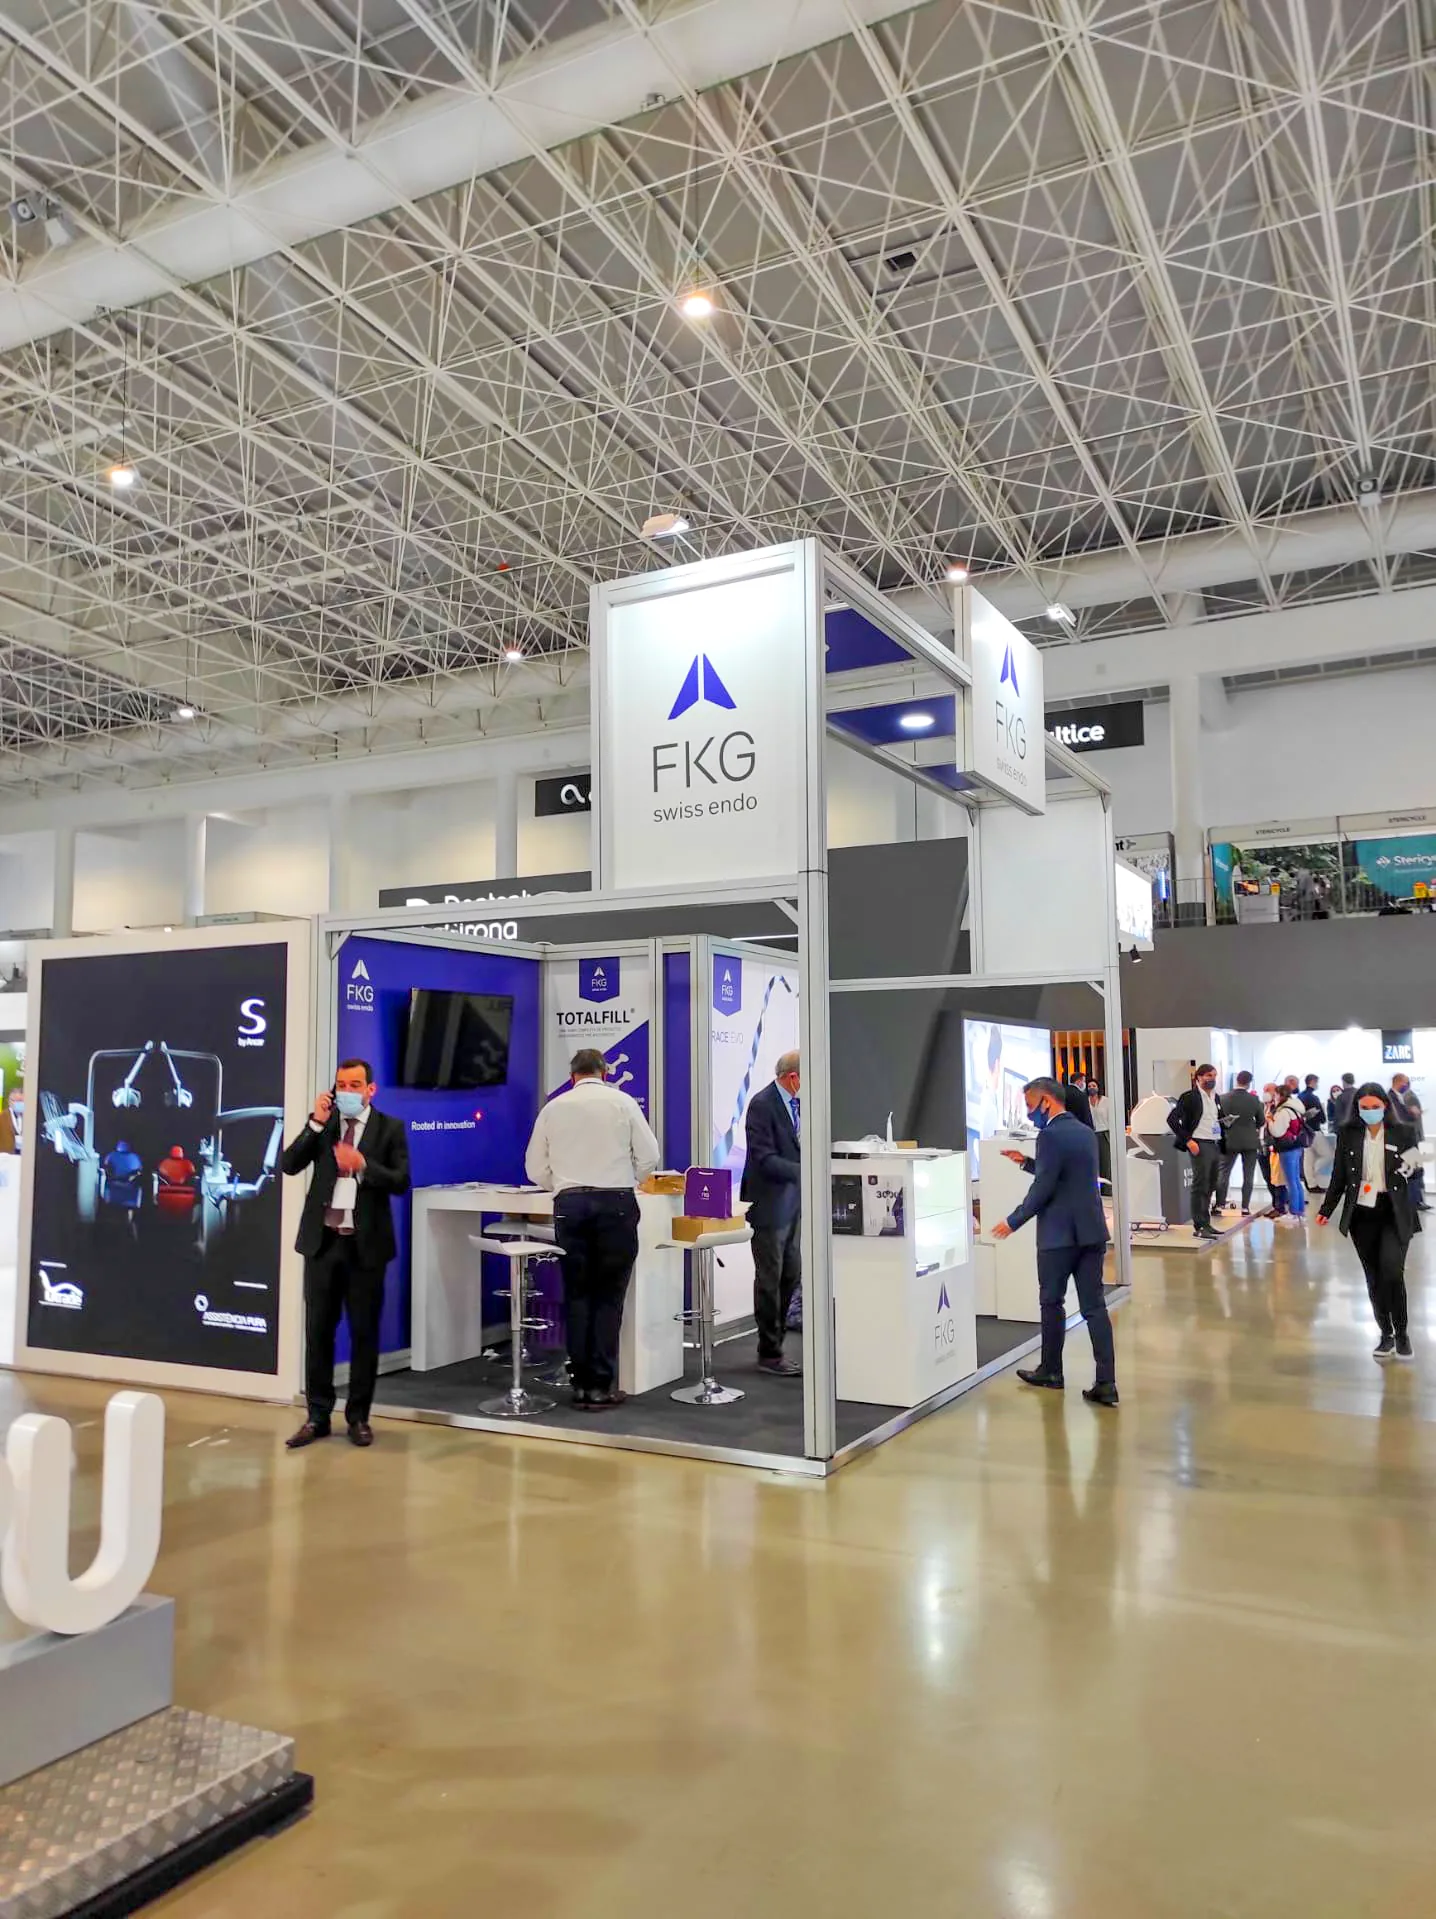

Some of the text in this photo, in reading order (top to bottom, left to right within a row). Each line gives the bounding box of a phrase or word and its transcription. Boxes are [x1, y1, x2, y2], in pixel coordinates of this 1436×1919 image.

[996, 700, 1027, 760] FKG
[652, 730, 756, 793] FKG
[652, 793, 758, 823] swiss endo
[592, 979, 607, 988] FKG
[722, 984, 733, 997] FKG
[347, 984, 374, 1003] FKG
[238, 999, 266, 1034] S
[556, 1010, 631, 1026] TOTALFILL
[1384, 1045, 1411, 1060] ZARC
[411, 1120, 475, 1131] Rooted in innovation
[934, 1319, 955, 1350] FKG
